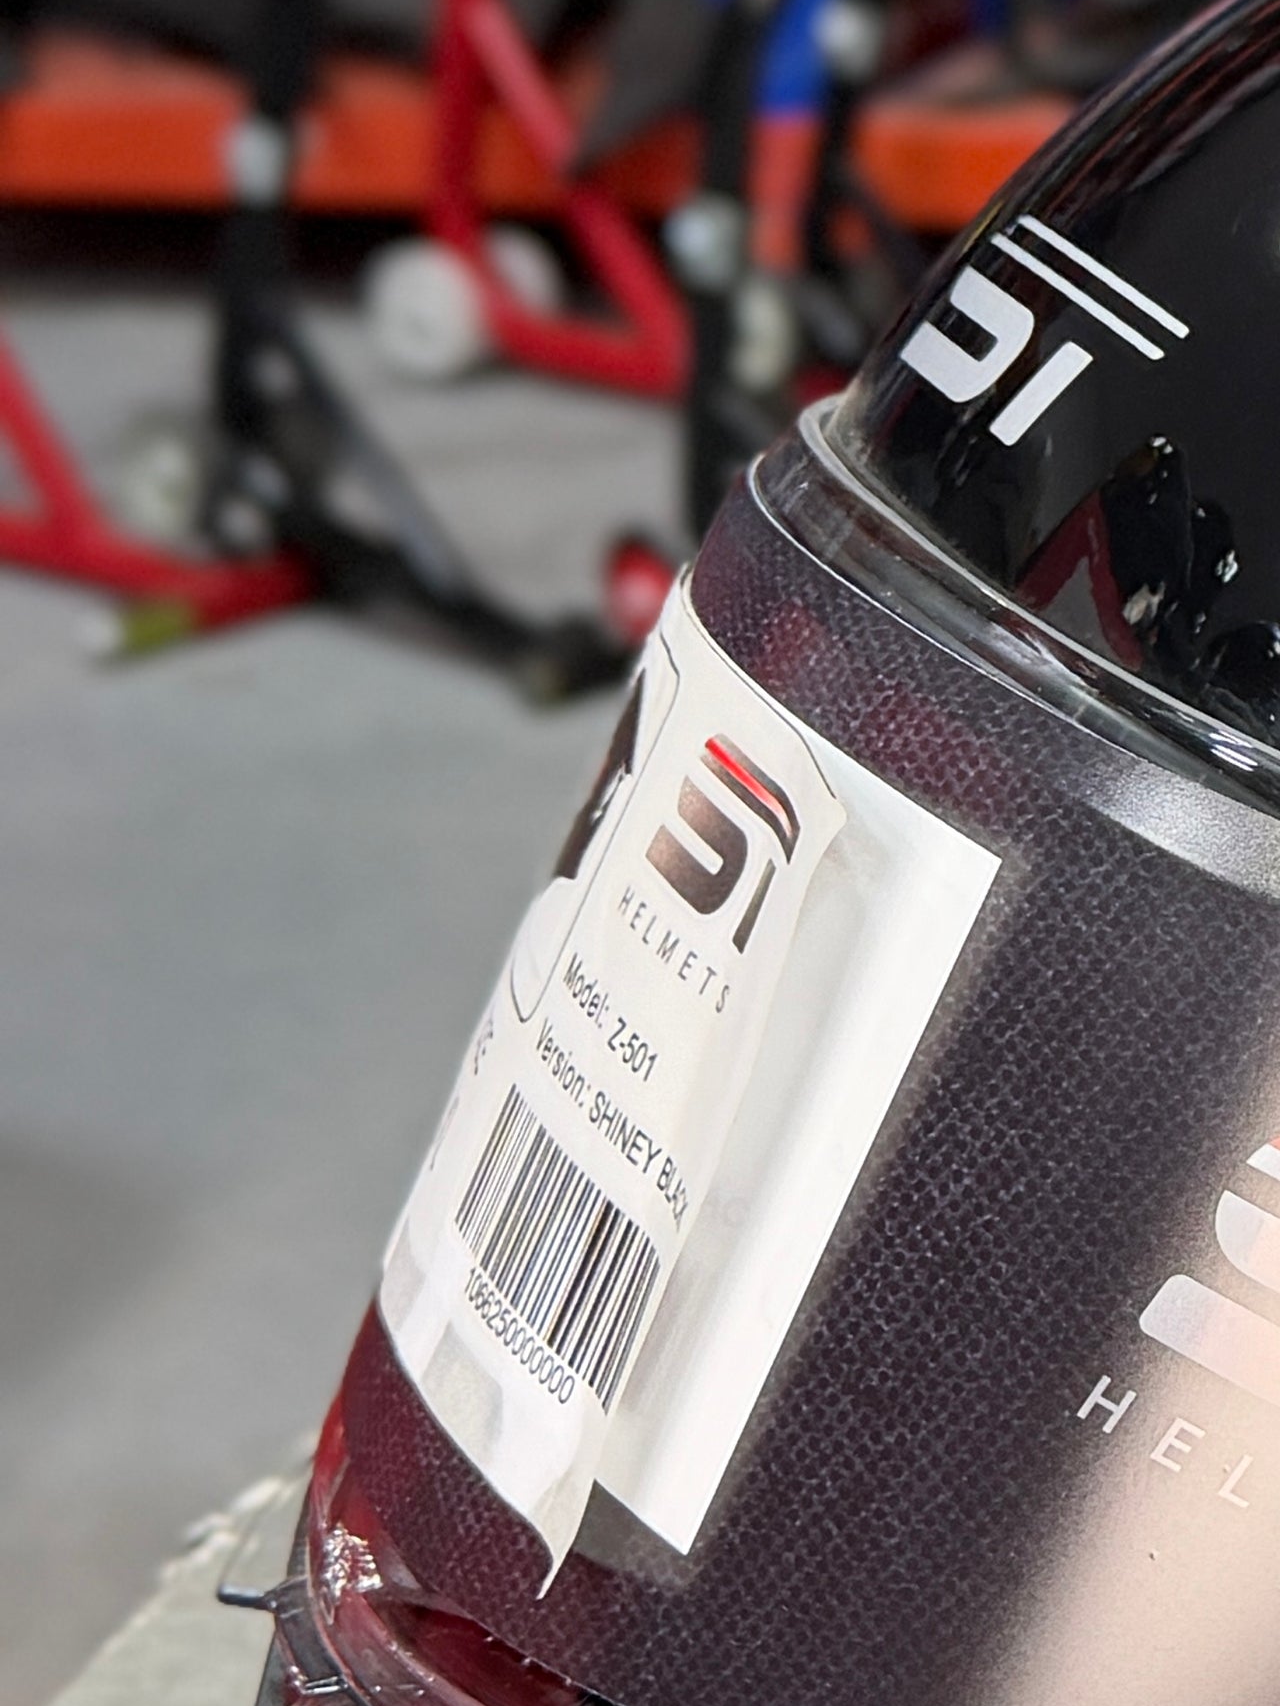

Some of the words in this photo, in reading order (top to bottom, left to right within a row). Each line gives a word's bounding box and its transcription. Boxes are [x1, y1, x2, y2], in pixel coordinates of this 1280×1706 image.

[617, 885, 731, 1014] HELMETS
[562, 951, 610, 1030] Model:
[606, 1016, 659, 1083] Z-501
[535, 1017, 593, 1109] Version:
[588, 1090, 663, 1175] SHINEY
